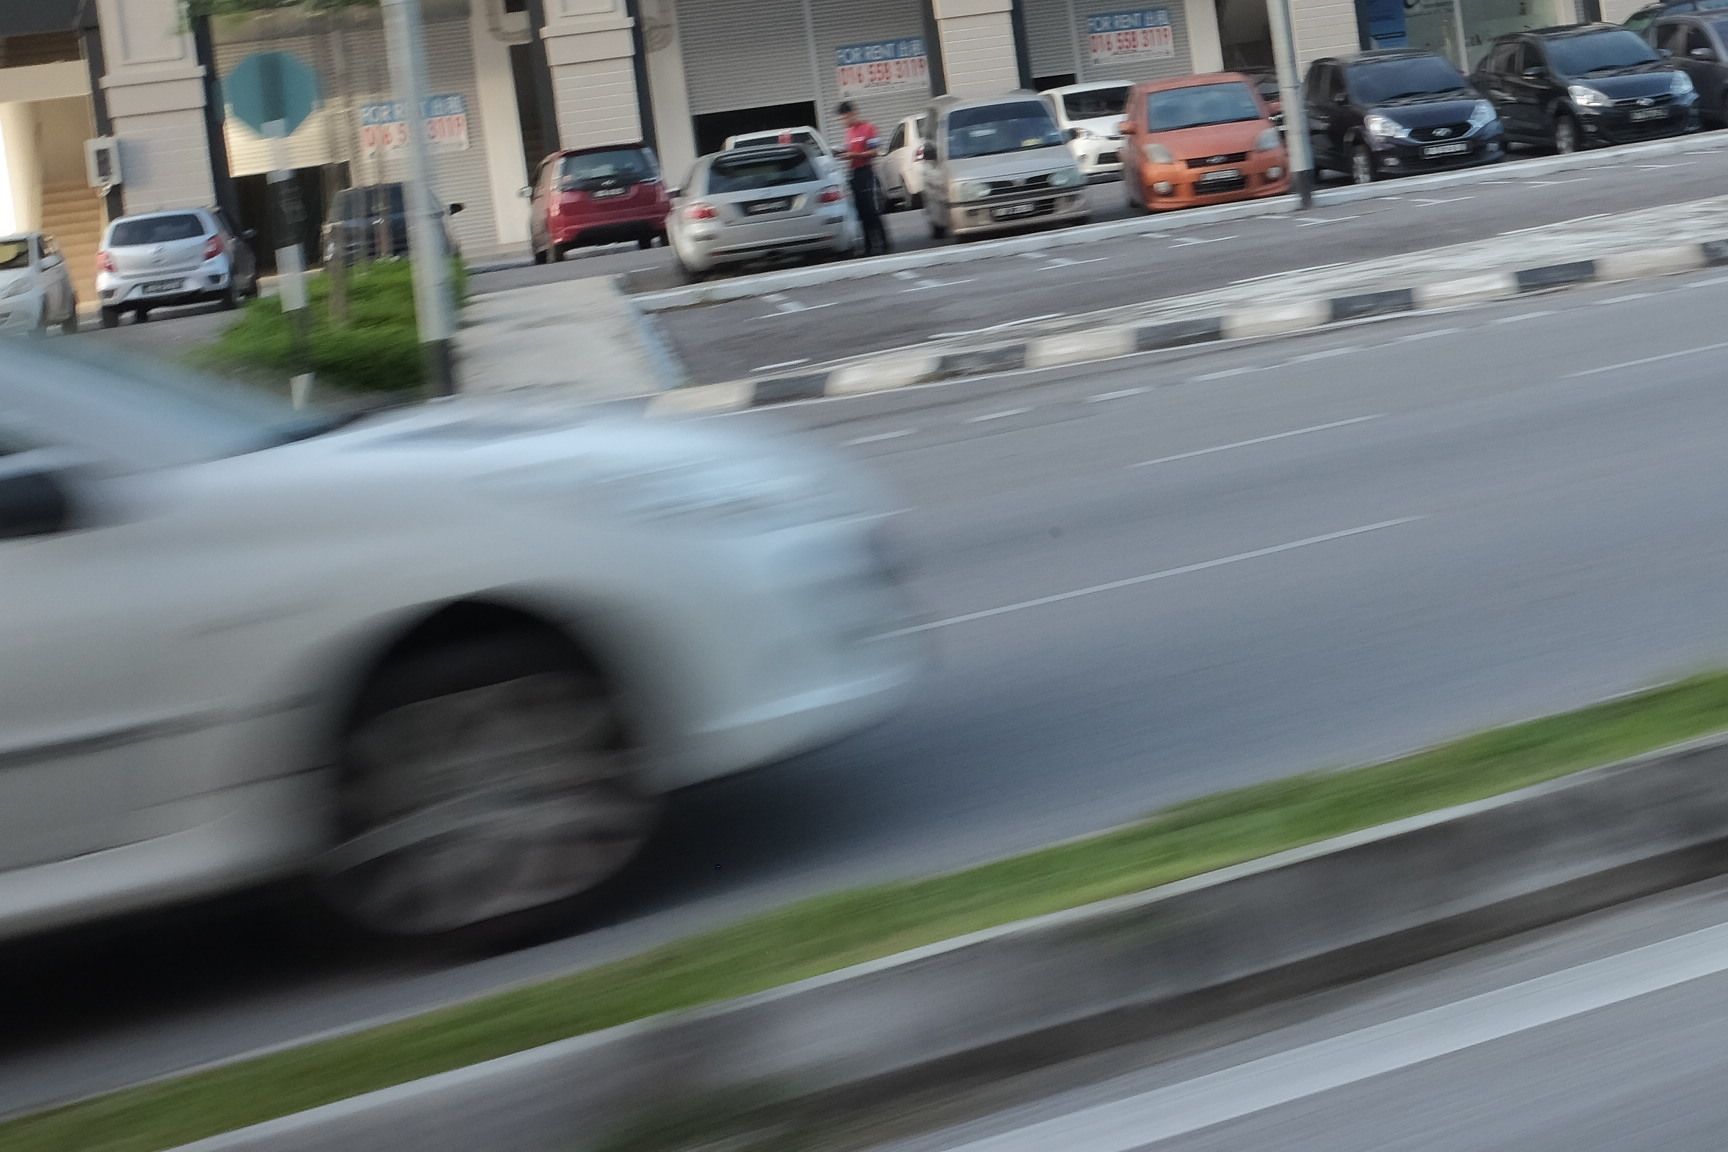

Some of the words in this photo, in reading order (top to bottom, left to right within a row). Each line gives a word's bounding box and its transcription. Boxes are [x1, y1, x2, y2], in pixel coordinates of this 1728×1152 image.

[1088, 16, 1112, 32] FOR
[1113, 13, 1142, 29] RENT
[837, 47, 864, 64] FOR
[865, 43, 897, 61] RENT
[361, 104, 391, 123] FOR
